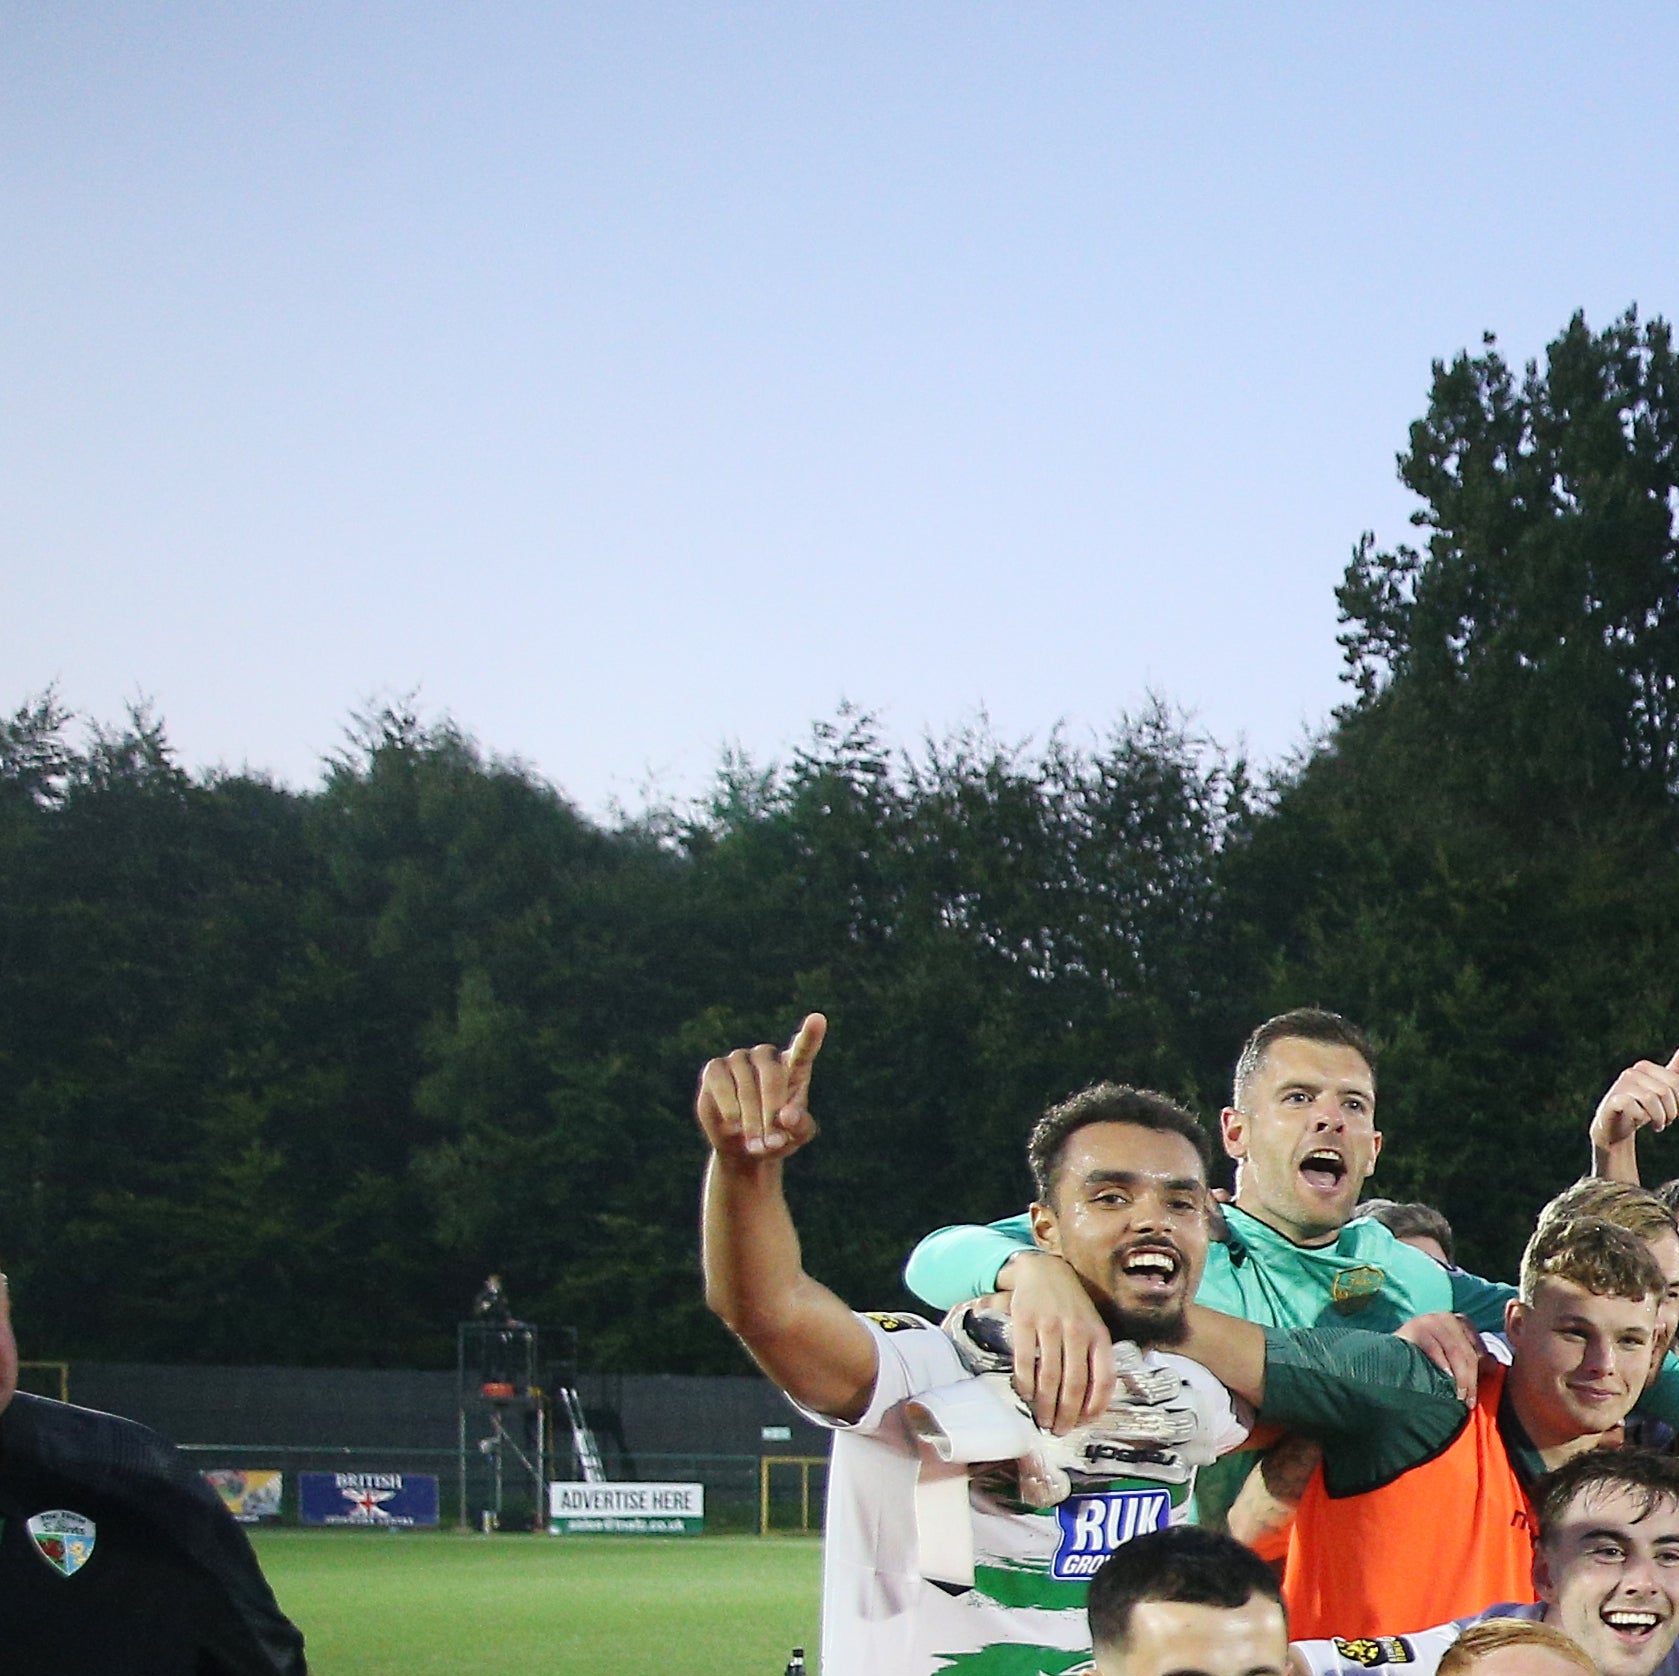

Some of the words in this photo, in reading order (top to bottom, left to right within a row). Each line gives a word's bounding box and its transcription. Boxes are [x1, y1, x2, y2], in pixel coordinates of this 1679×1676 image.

[335, 1472, 402, 1489] BRITISH
[561, 1489, 646, 1510] ADVERTISE
[653, 1491, 692, 1510] HERE
[1071, 1495, 1165, 1551] RUK
